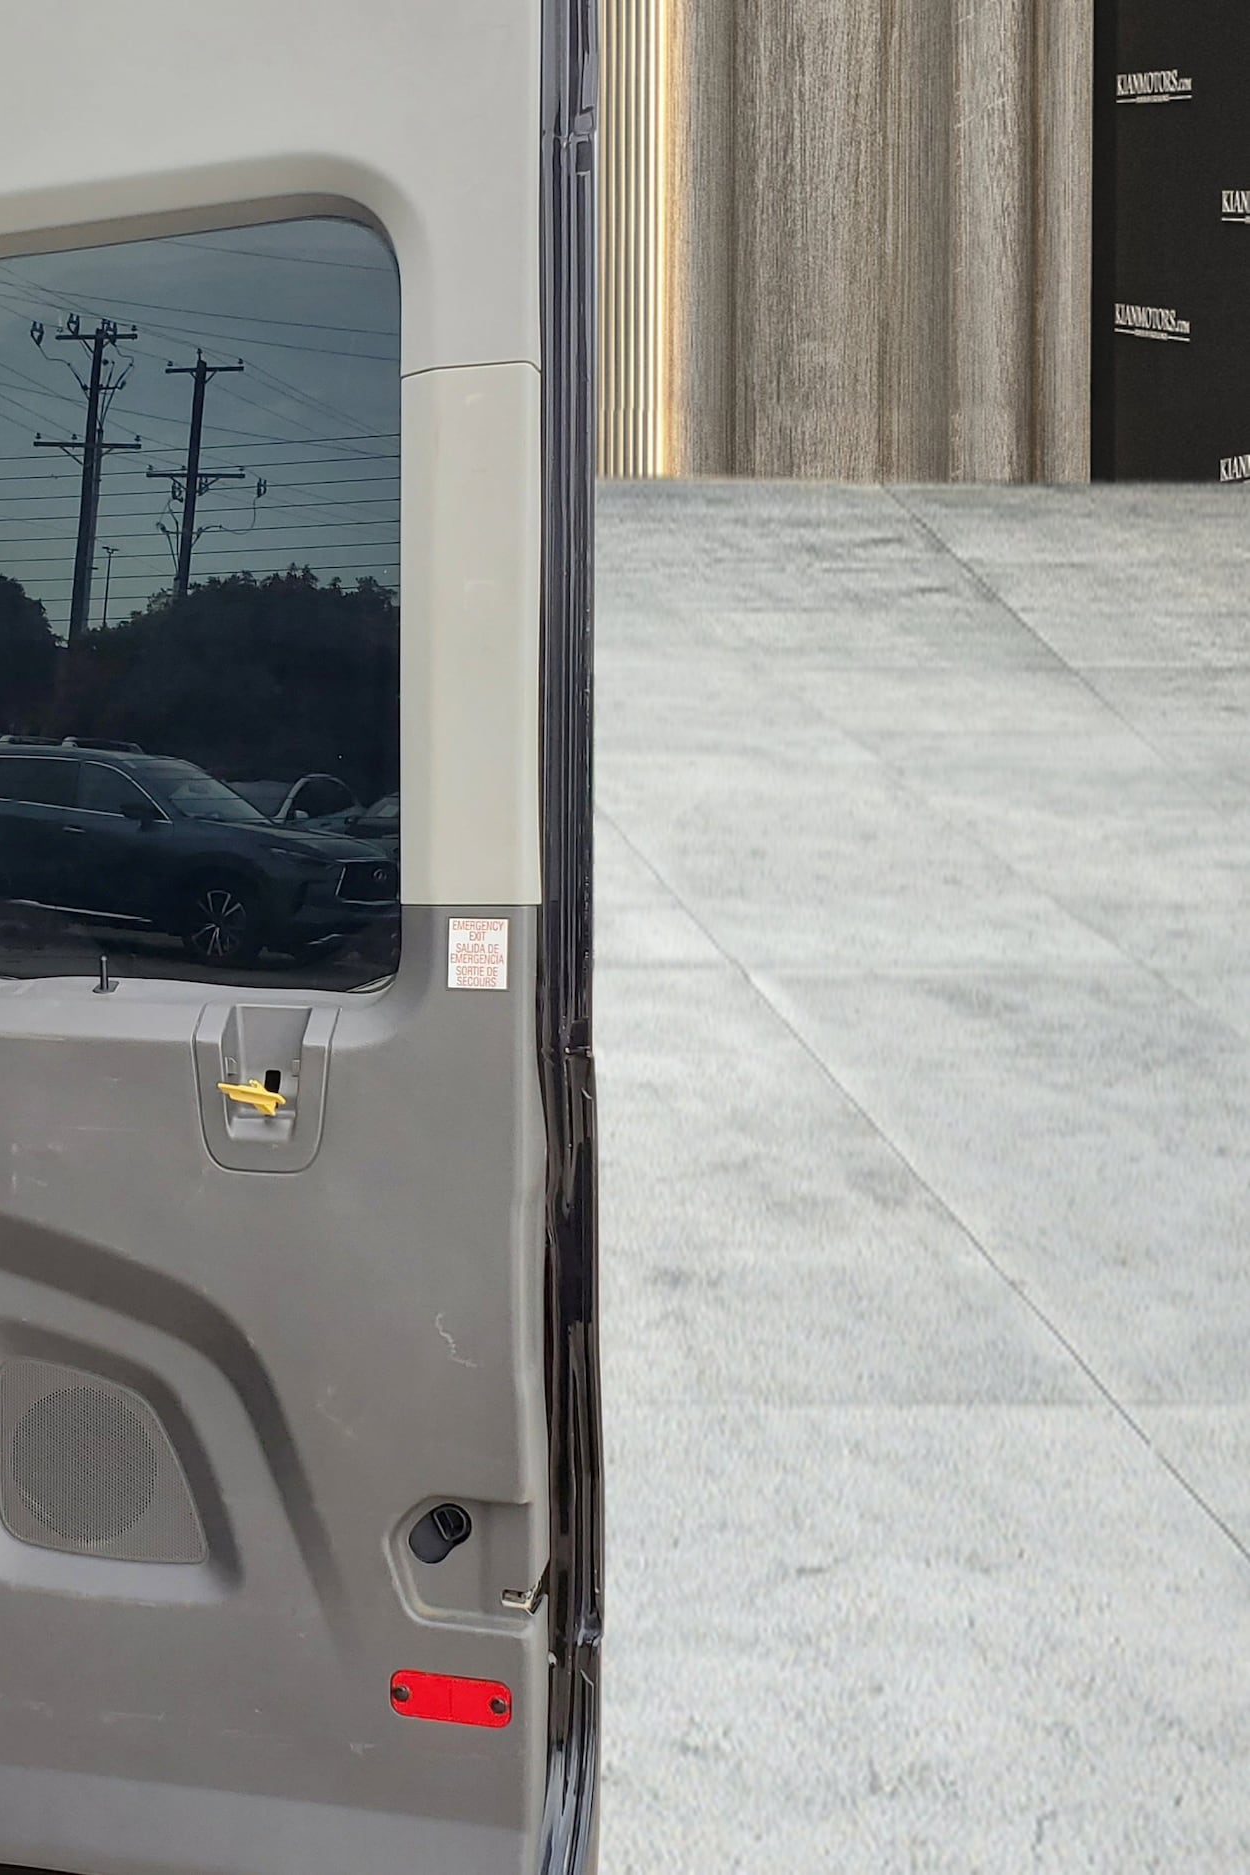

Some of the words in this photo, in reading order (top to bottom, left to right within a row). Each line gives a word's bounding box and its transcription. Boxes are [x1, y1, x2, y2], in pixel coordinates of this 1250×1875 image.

[452, 920, 504, 931] EMERGENCY
[469, 931, 486, 941] EXIT
[455, 943, 485, 953] SALIDA
[487, 944, 500, 953] DE
[450, 953, 504, 964] EMERGENCIA
[455, 966, 485, 976] SORTIE
[487, 967, 499, 976] DE
[456, 976, 497, 987] SECOURS
